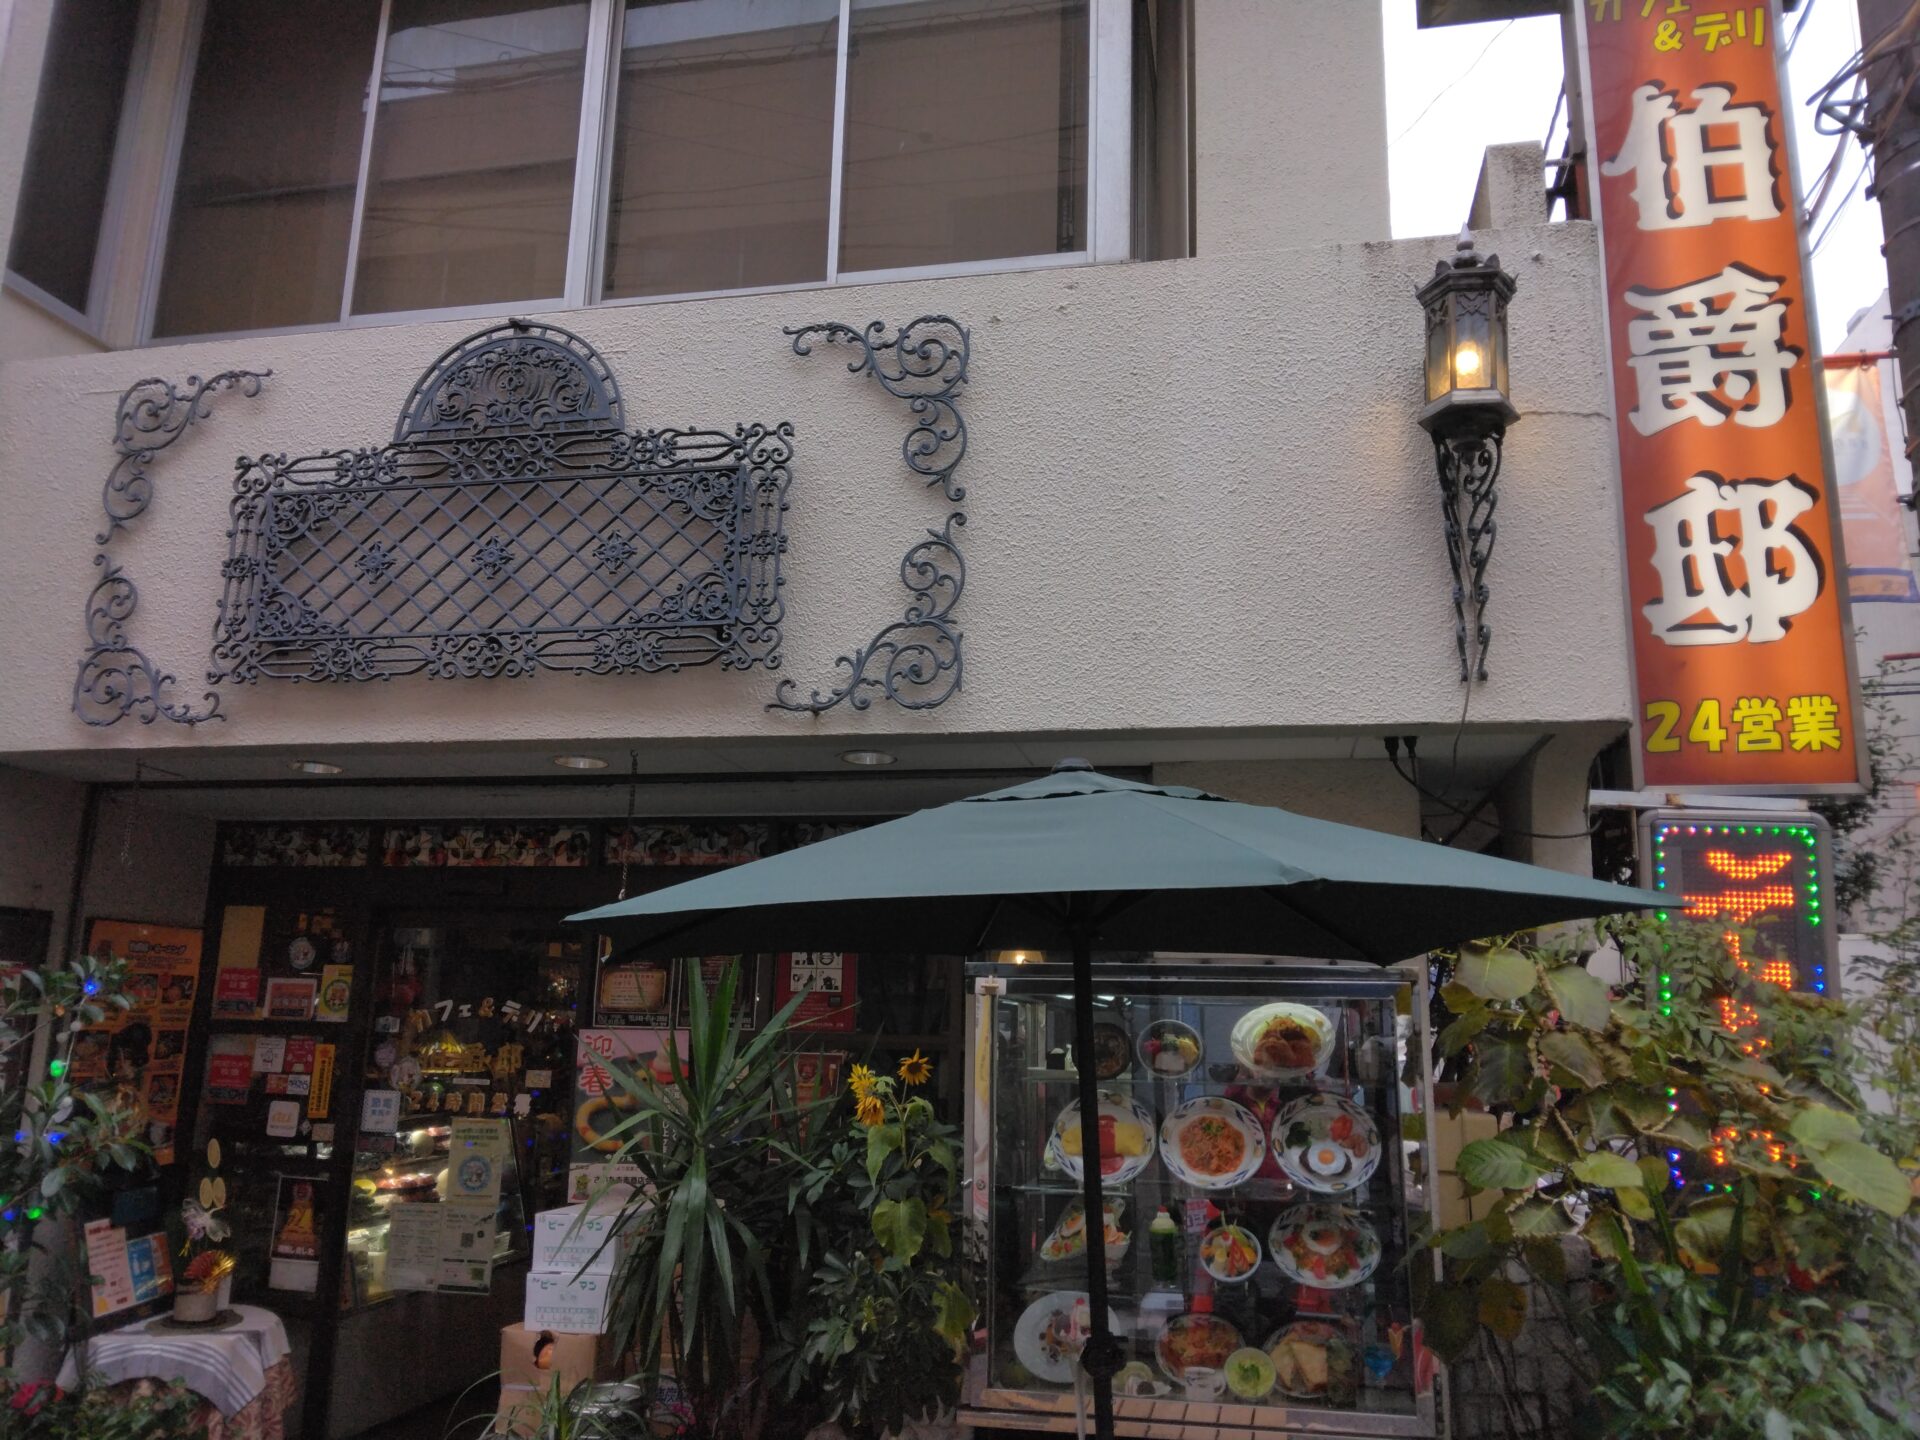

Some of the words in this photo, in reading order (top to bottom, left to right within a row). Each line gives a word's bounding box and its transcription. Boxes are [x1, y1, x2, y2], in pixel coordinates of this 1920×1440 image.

[1601, 81, 1824, 647] 伯爵邸
[1645, 695, 1843, 753] 24営業
